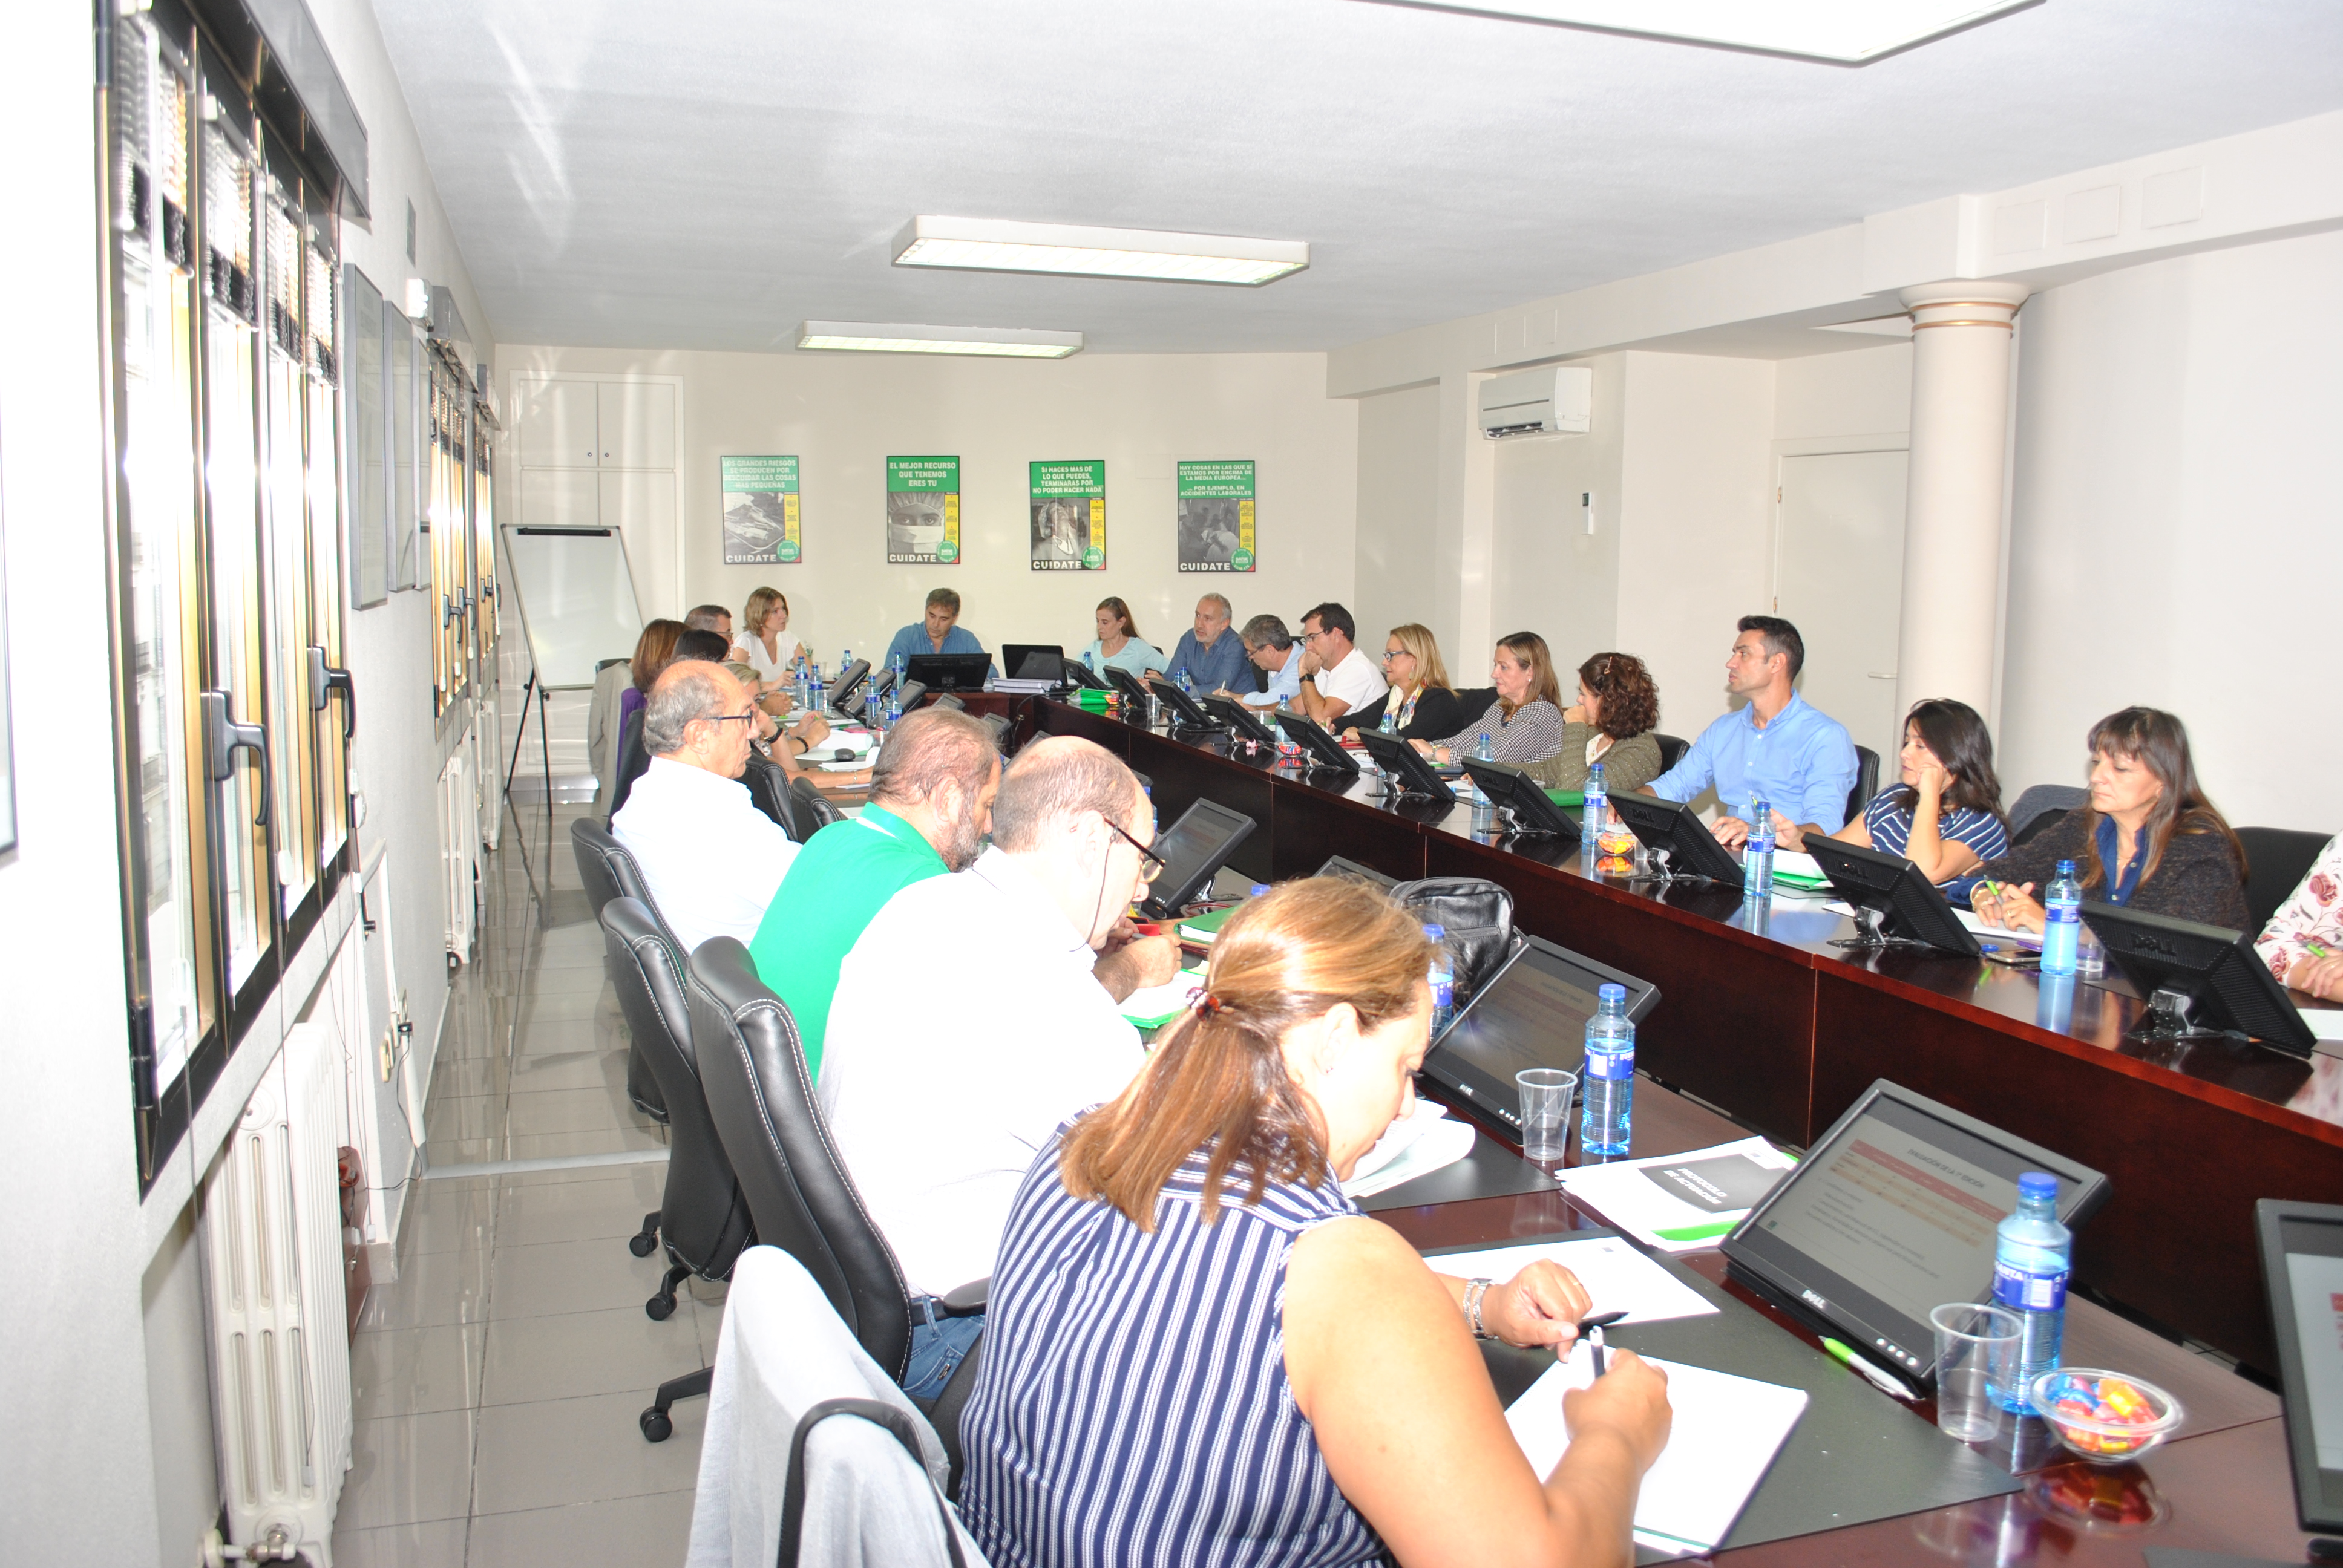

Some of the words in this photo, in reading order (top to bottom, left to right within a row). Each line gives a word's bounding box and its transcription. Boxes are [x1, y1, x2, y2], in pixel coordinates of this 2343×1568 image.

[726, 554, 777, 563] CUIDATE
[889, 554, 937, 563] CUIDATE
[1033, 561, 1082, 569] CUIDATE
[1180, 563, 1231, 571] CUIDATE
[1632, 808, 1654, 823] DELL
[1839, 861, 1868, 880] DELL
[2131, 932, 2176, 956] DELL
[1674, 1177, 1722, 1204] ACTUACIÓN
[1677, 1168, 1727, 1197] PROTOCOLO
[1801, 1289, 1826, 1308] DELL
